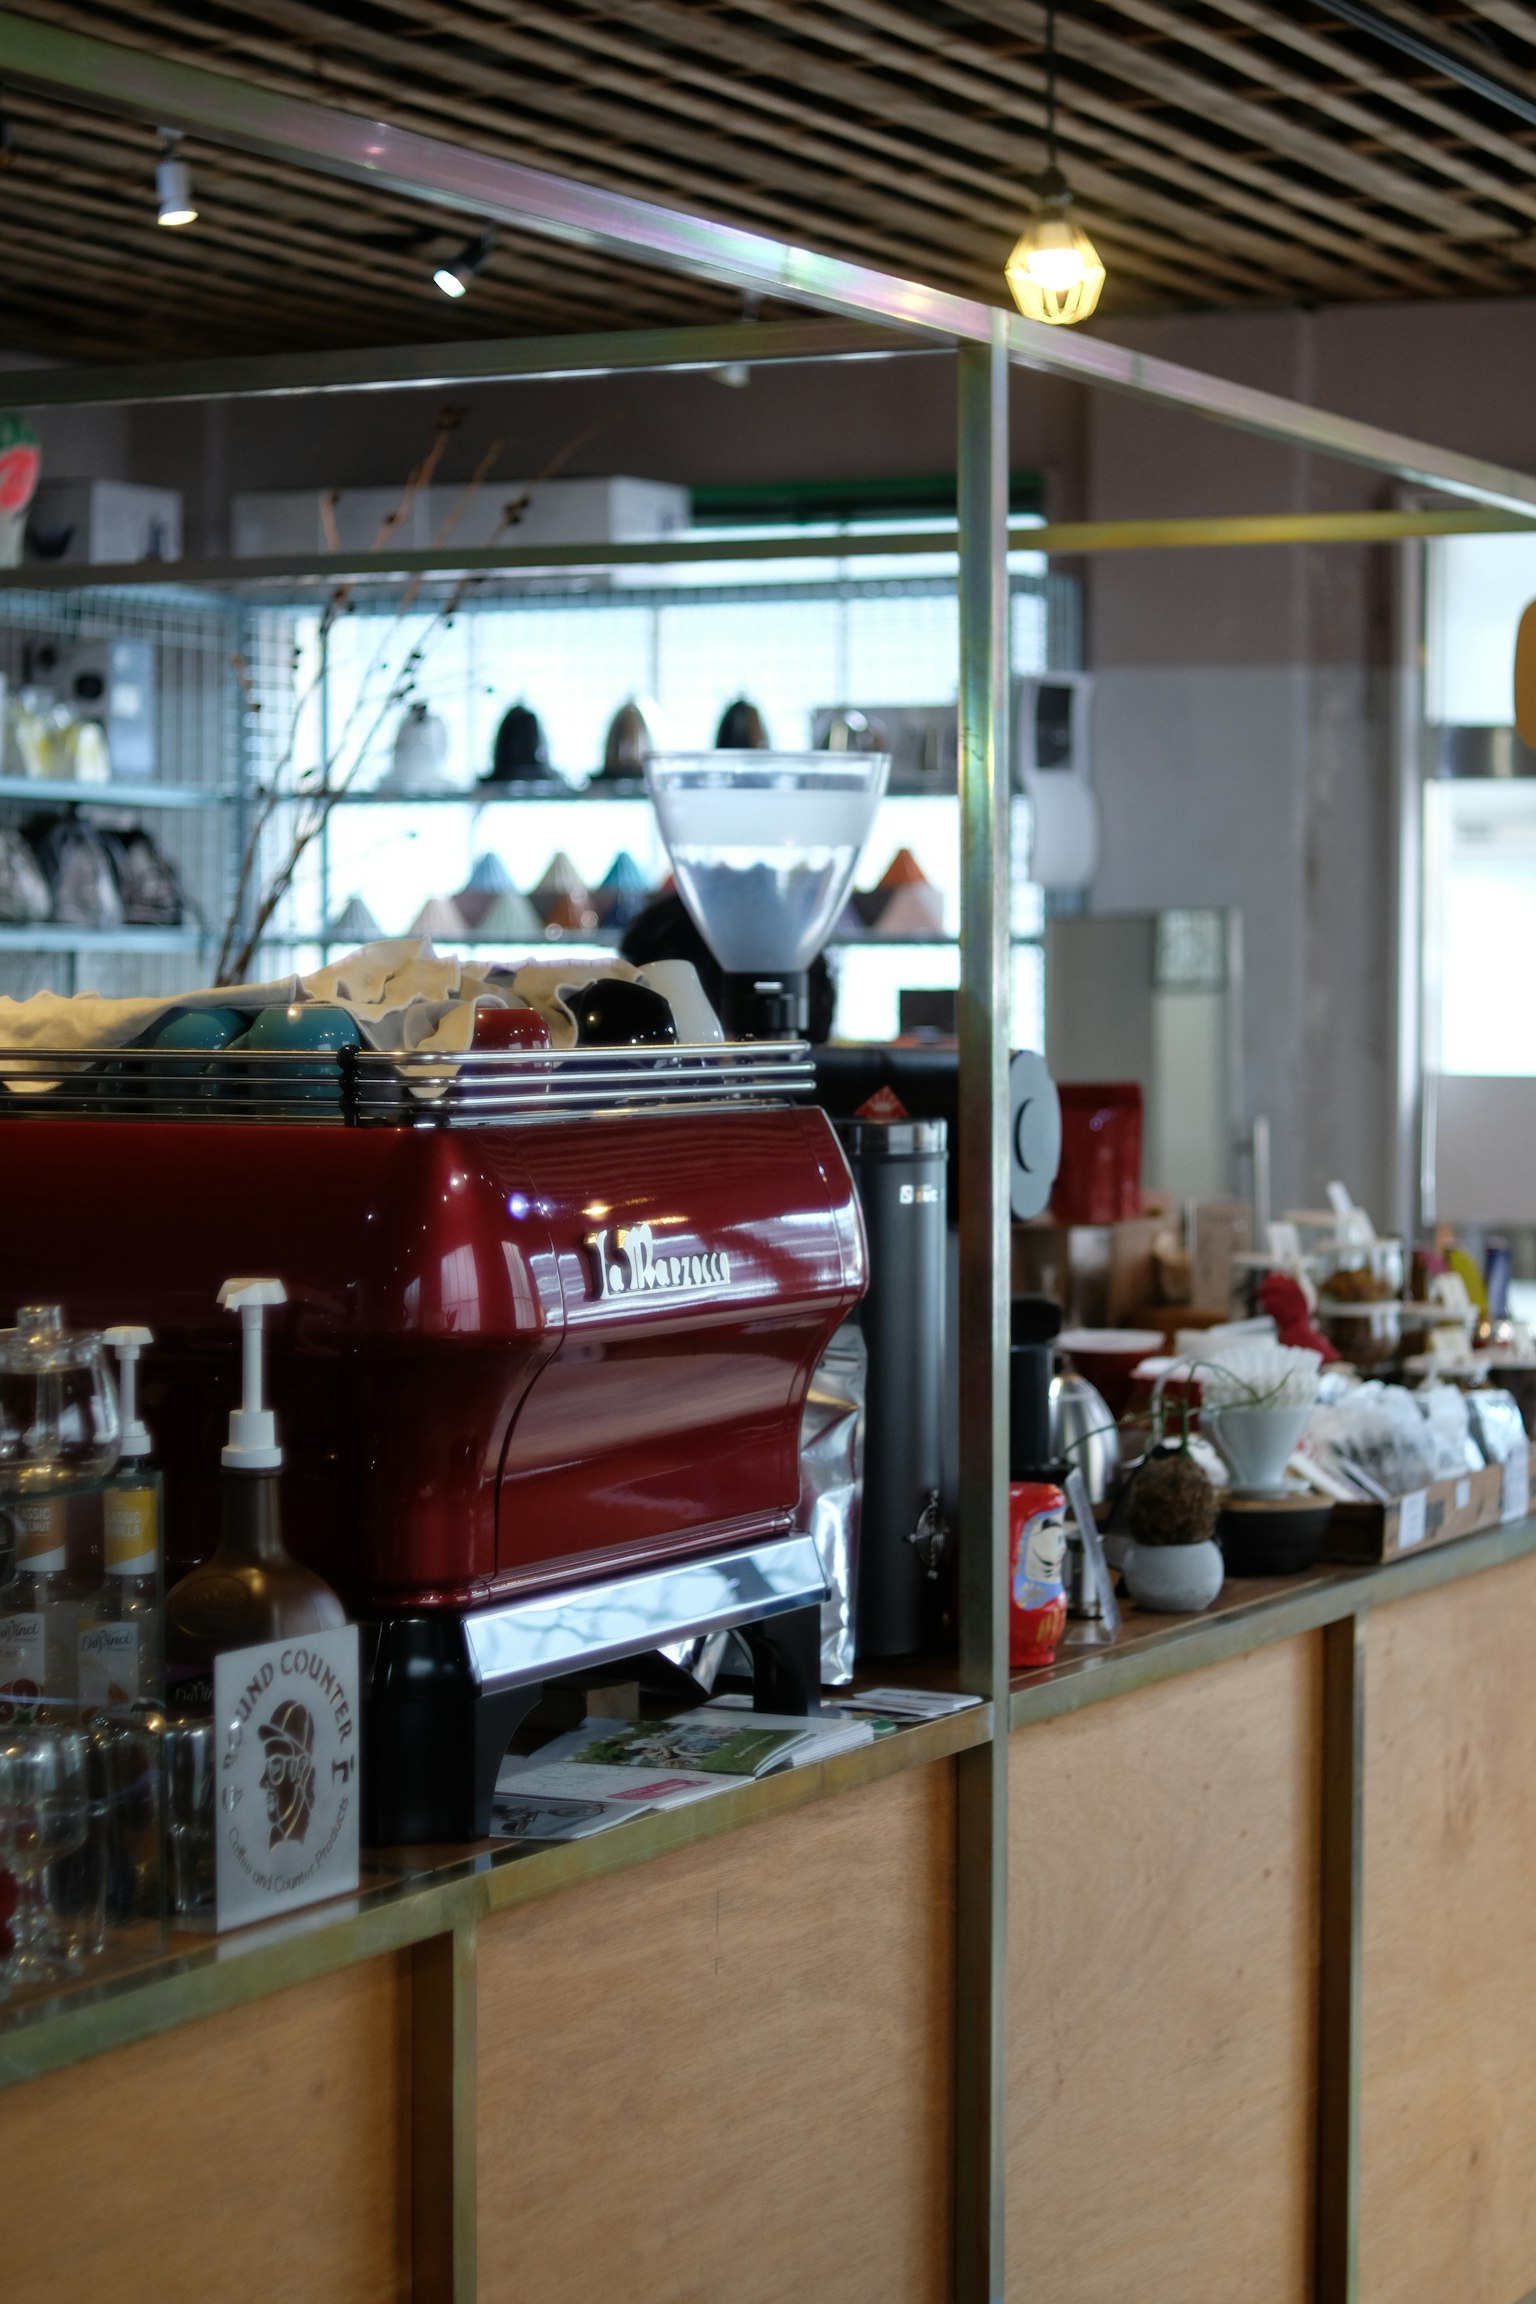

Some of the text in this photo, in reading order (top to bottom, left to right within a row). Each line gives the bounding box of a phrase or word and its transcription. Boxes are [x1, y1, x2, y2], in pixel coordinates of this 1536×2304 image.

[623, 1223, 731, 1291] Marzocco
[0, 1620, 39, 1643] aVinci
[80, 1630, 131, 1654] DaVinci
[280, 1649, 353, 1745] COUNTER
[228, 1797, 349, 1893] Coffee and Counter Products
